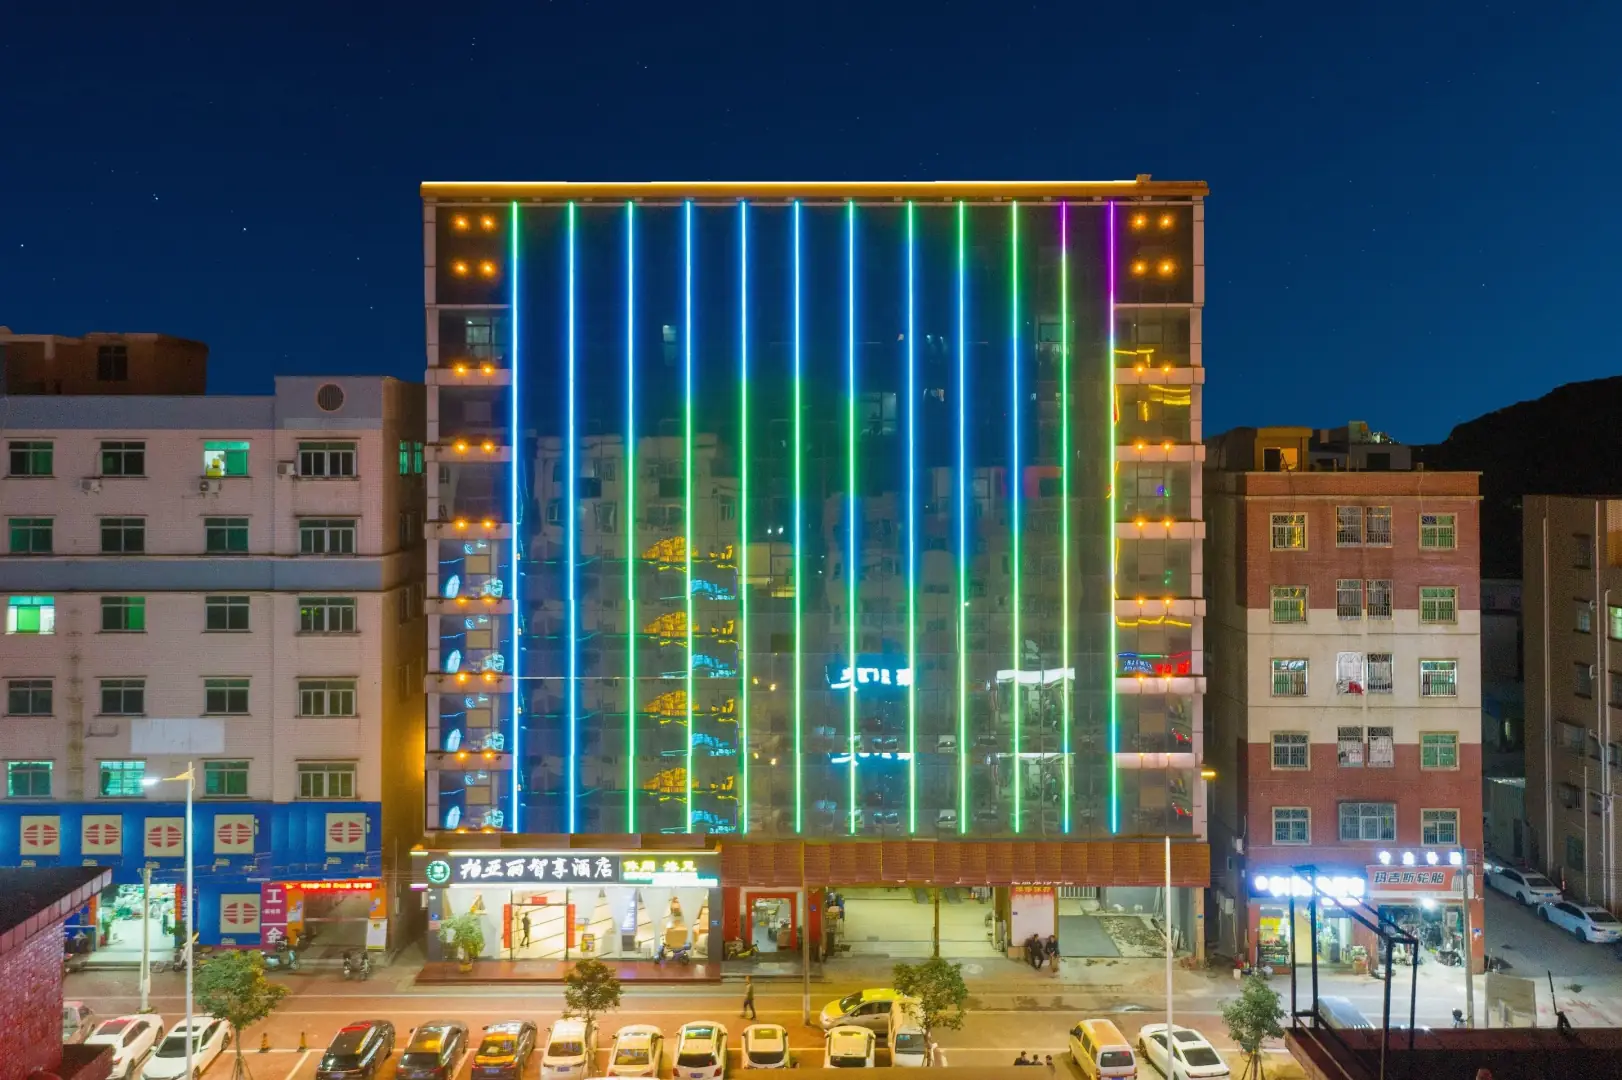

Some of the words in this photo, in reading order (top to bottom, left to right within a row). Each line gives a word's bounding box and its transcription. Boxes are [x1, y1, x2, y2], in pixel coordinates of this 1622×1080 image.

[1374, 871, 1445, 885] 玛吉斯轮胎
[266, 889, 282, 903] 工
